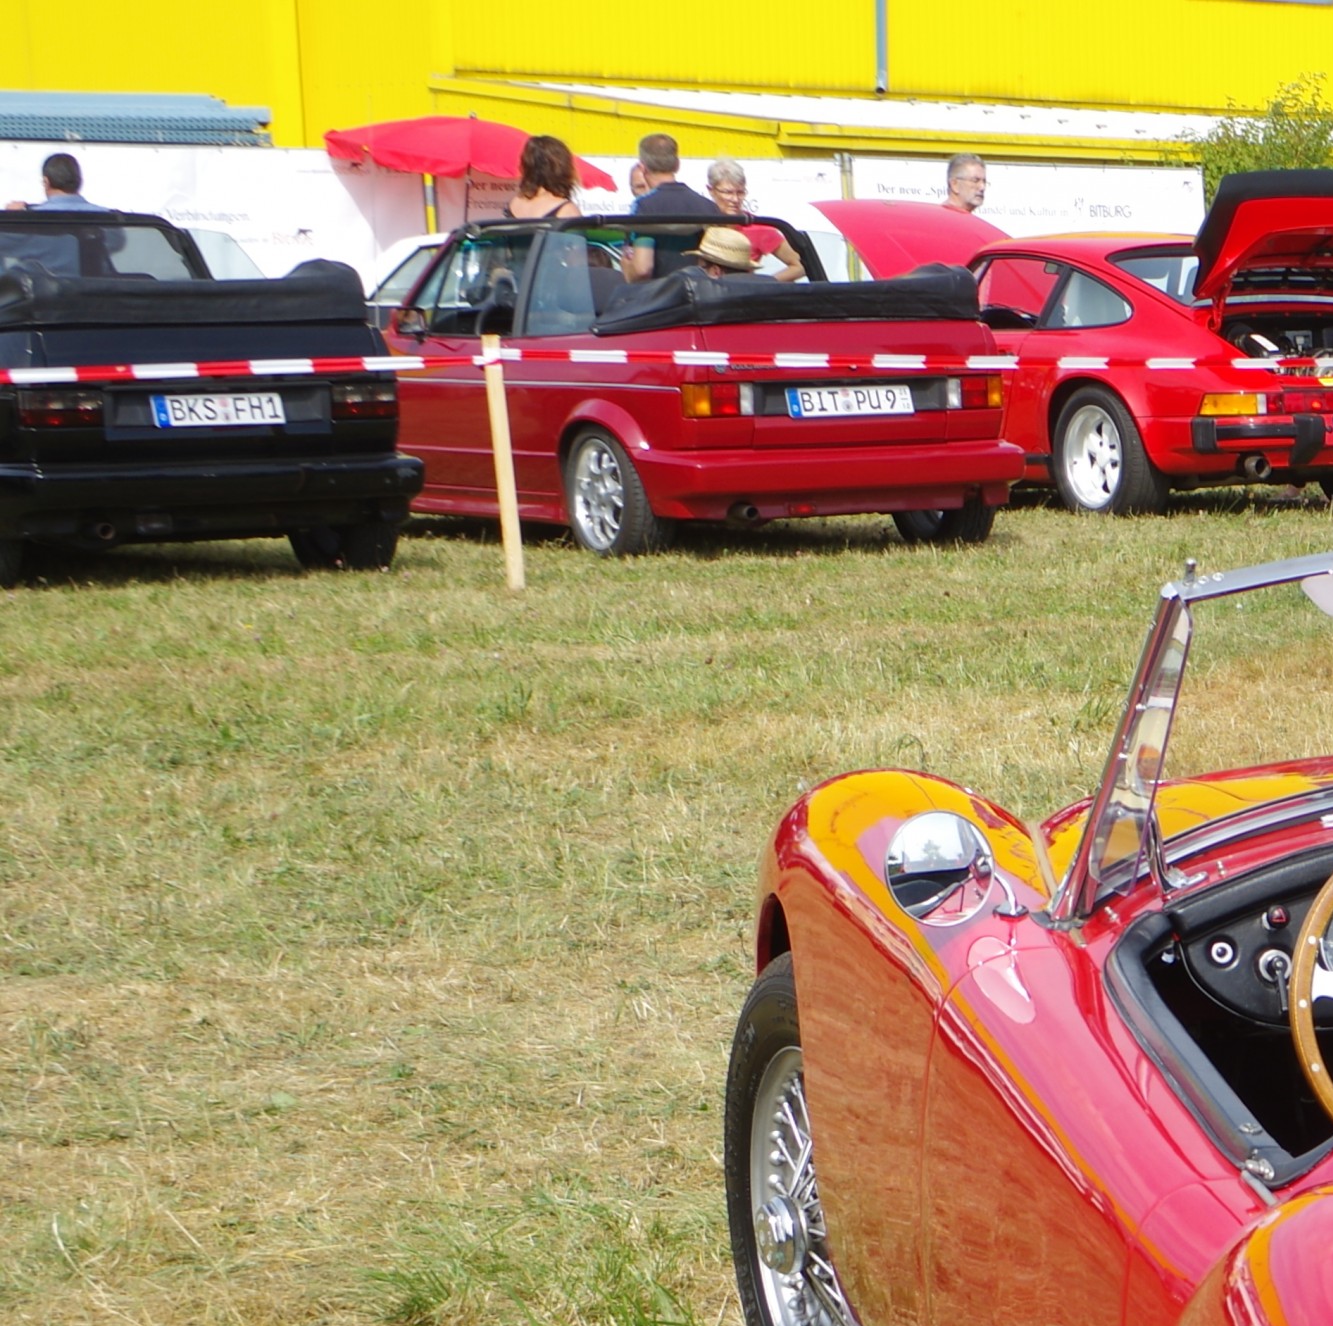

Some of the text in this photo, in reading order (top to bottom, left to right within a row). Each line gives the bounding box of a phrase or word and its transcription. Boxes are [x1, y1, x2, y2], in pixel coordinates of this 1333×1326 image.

[877, 183, 895, 194] Der
[899, 187, 921, 195] neue
[1089, 205, 1133, 218] BITBURG
[170, 398, 217, 421] BKS
[801, 391, 839, 412] BIT
[853, 389, 882, 410] PU
[885, 389, 897, 409] 9
